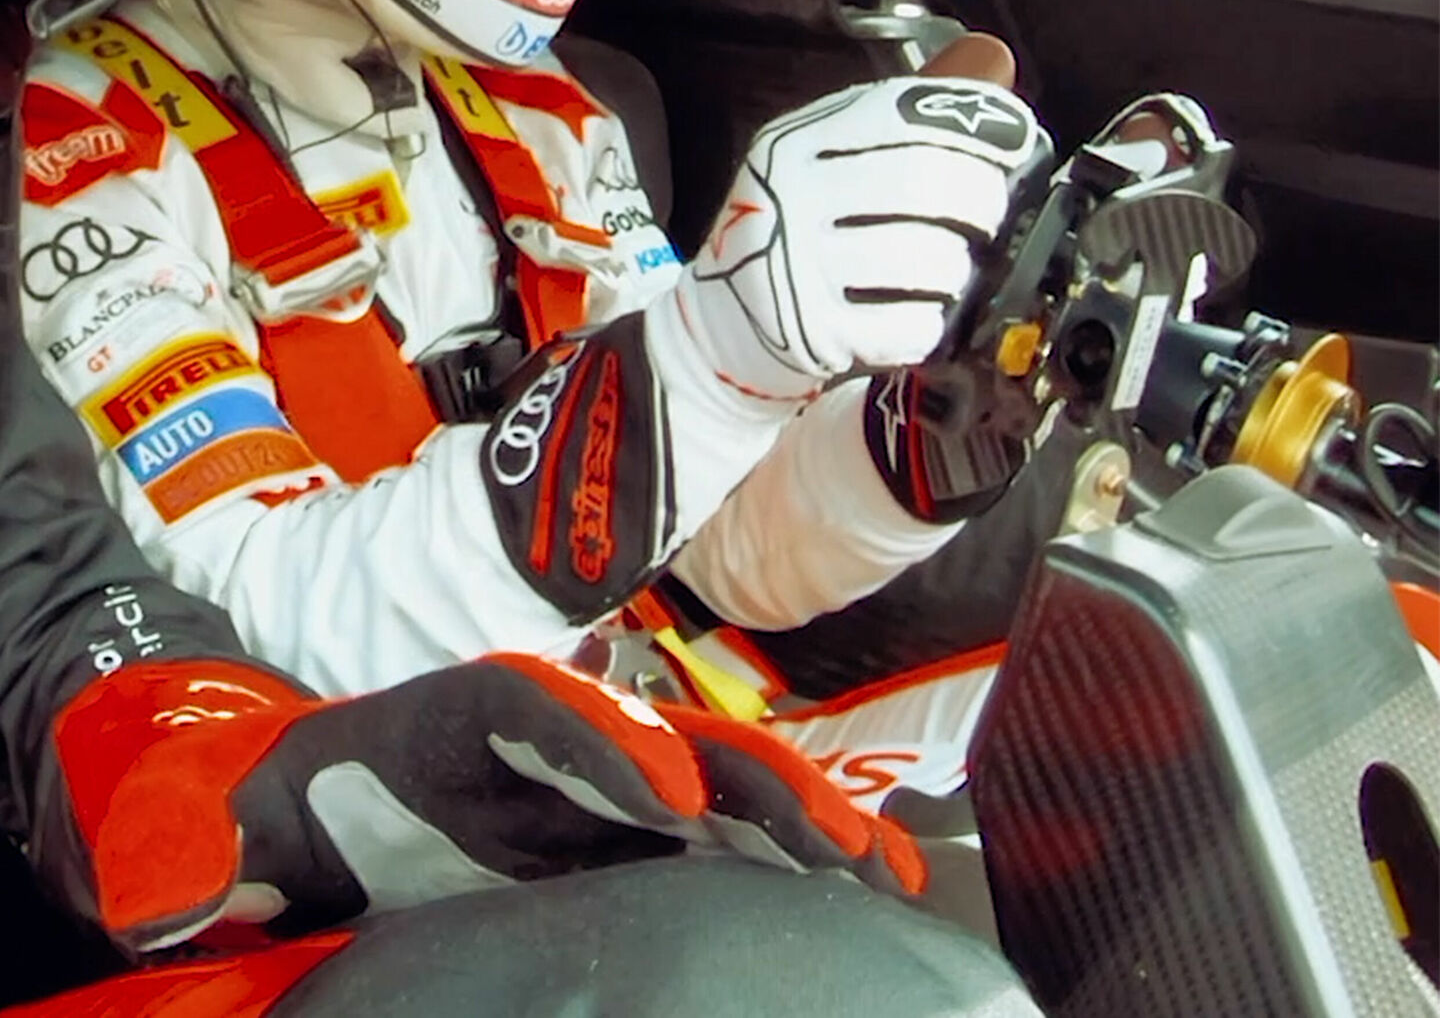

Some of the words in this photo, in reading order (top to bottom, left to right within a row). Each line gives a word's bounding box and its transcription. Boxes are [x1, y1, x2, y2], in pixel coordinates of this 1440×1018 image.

[48, 282, 168, 363] BLANCPAI
[87, 345, 113, 373] GT
[133, 409, 215, 476] AUTO
